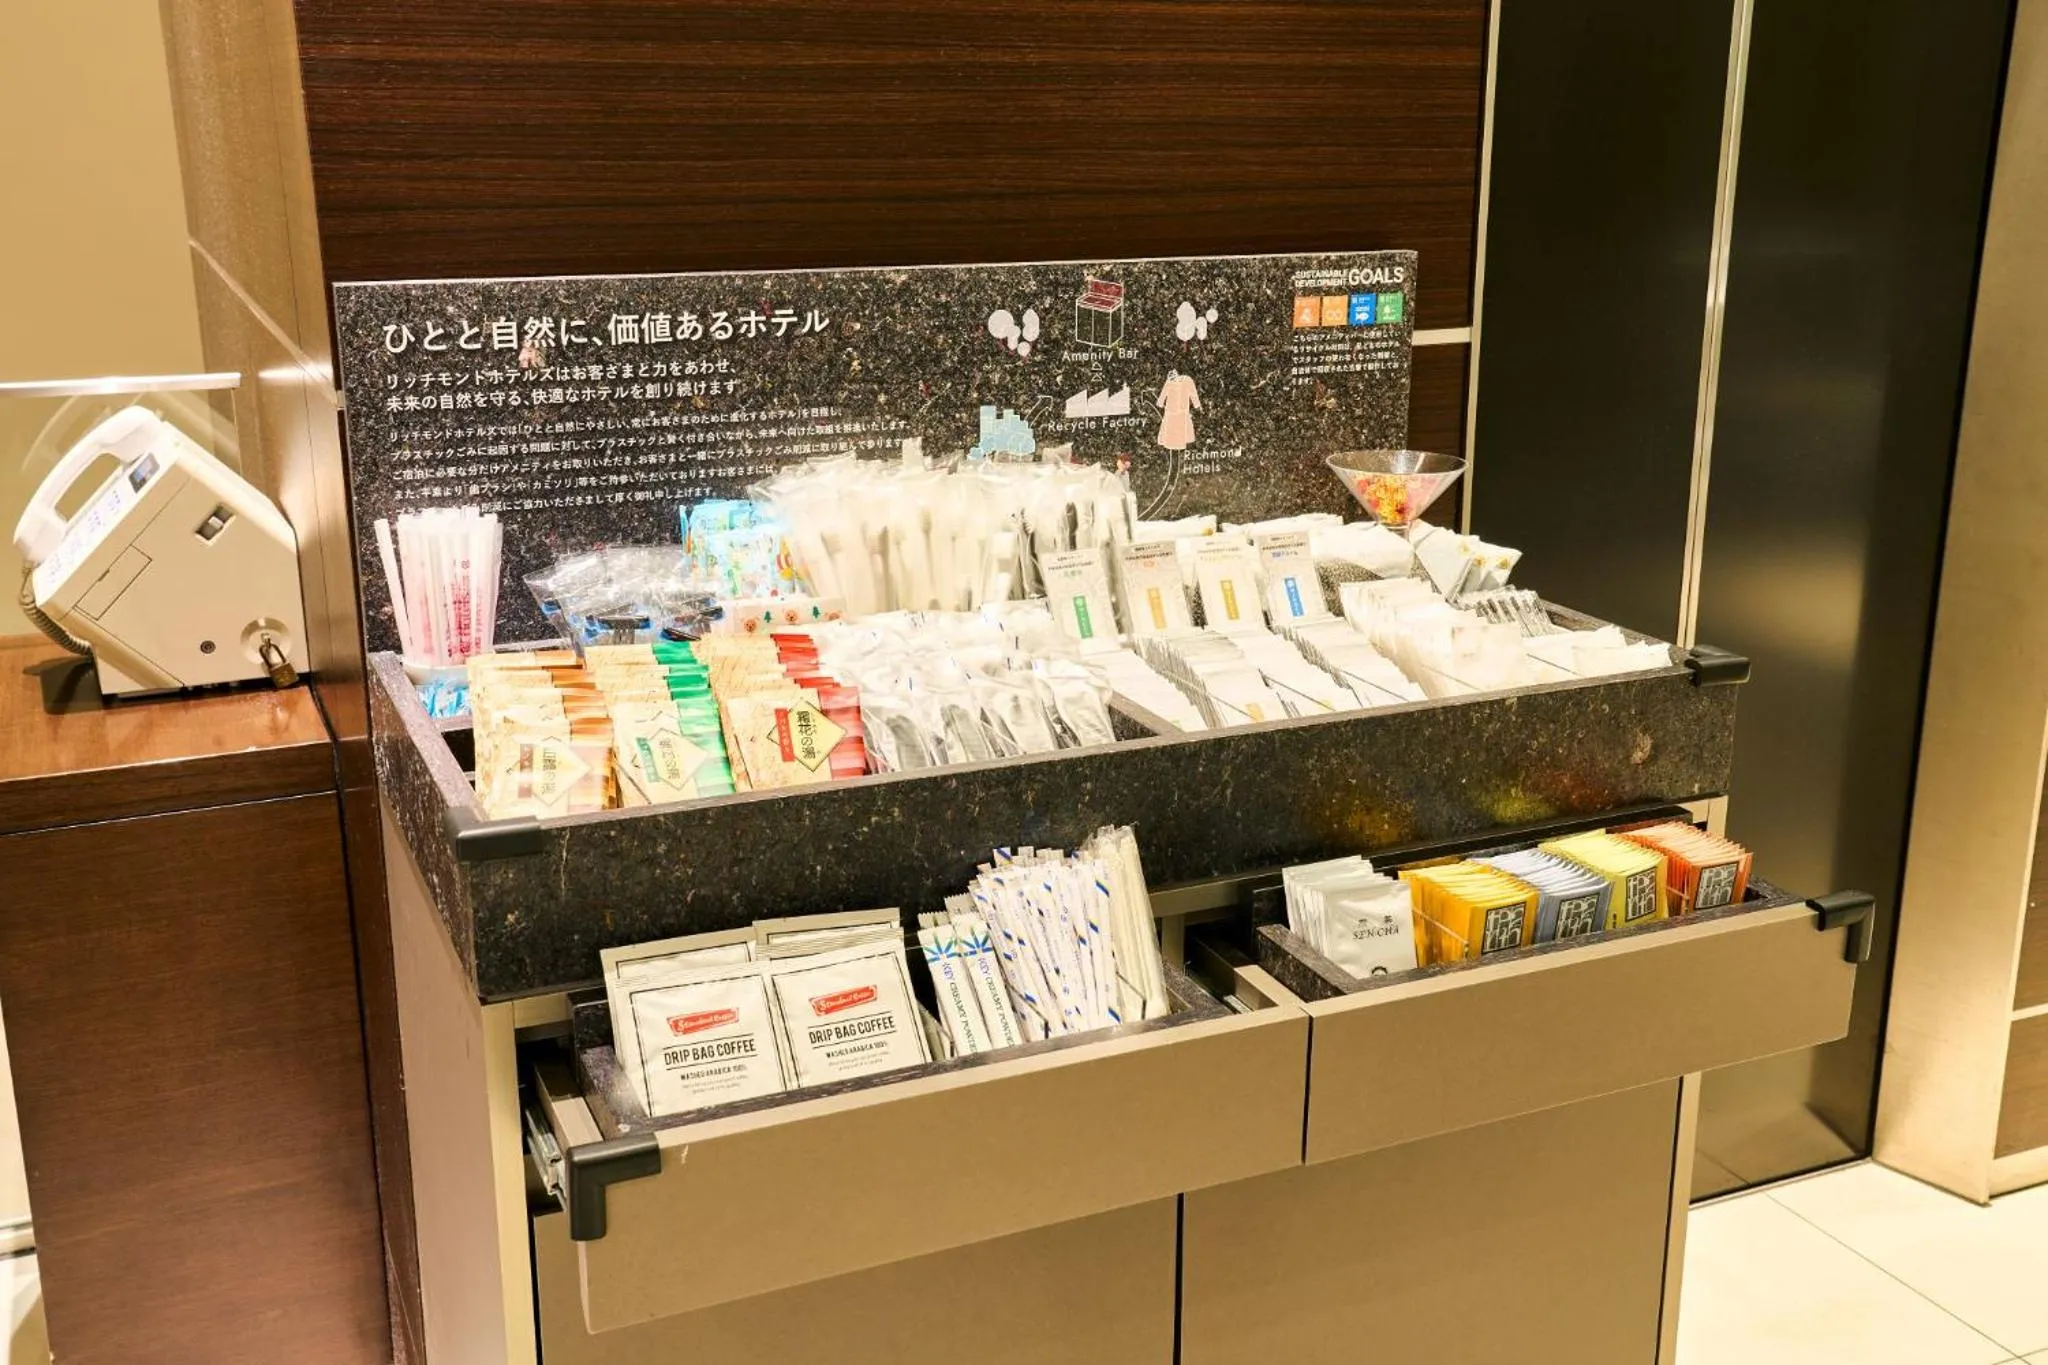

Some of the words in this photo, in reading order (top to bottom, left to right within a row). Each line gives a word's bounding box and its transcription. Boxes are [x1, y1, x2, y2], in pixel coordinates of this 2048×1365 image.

[1348, 267, 1404, 286] GOALS
[383, 309, 830, 353] ひとと自然に、価値あるホテル
[1062, 350, 1114, 363] Amenity
[1118, 347, 1140, 360] Bar
[386, 358, 737, 390] リッチモンドホテルズはお客さまと力をあわせ、
[386, 380, 738, 412] 未来の自然を守る、快適なホテルを創り続けます
[1048, 420, 1097, 433] Recycle
[1102, 417, 1148, 429] Factory
[1353, 925, 1399, 940] SENCHA
[808, 1028, 833, 1044] DRIP
[834, 1023, 857, 1040] BAG
[857, 1016, 895, 1035] COFFEE
[664, 1049, 690, 1066] DRIP
[691, 1045, 715, 1061] BAG
[716, 1038, 757, 1057] COFFEE
